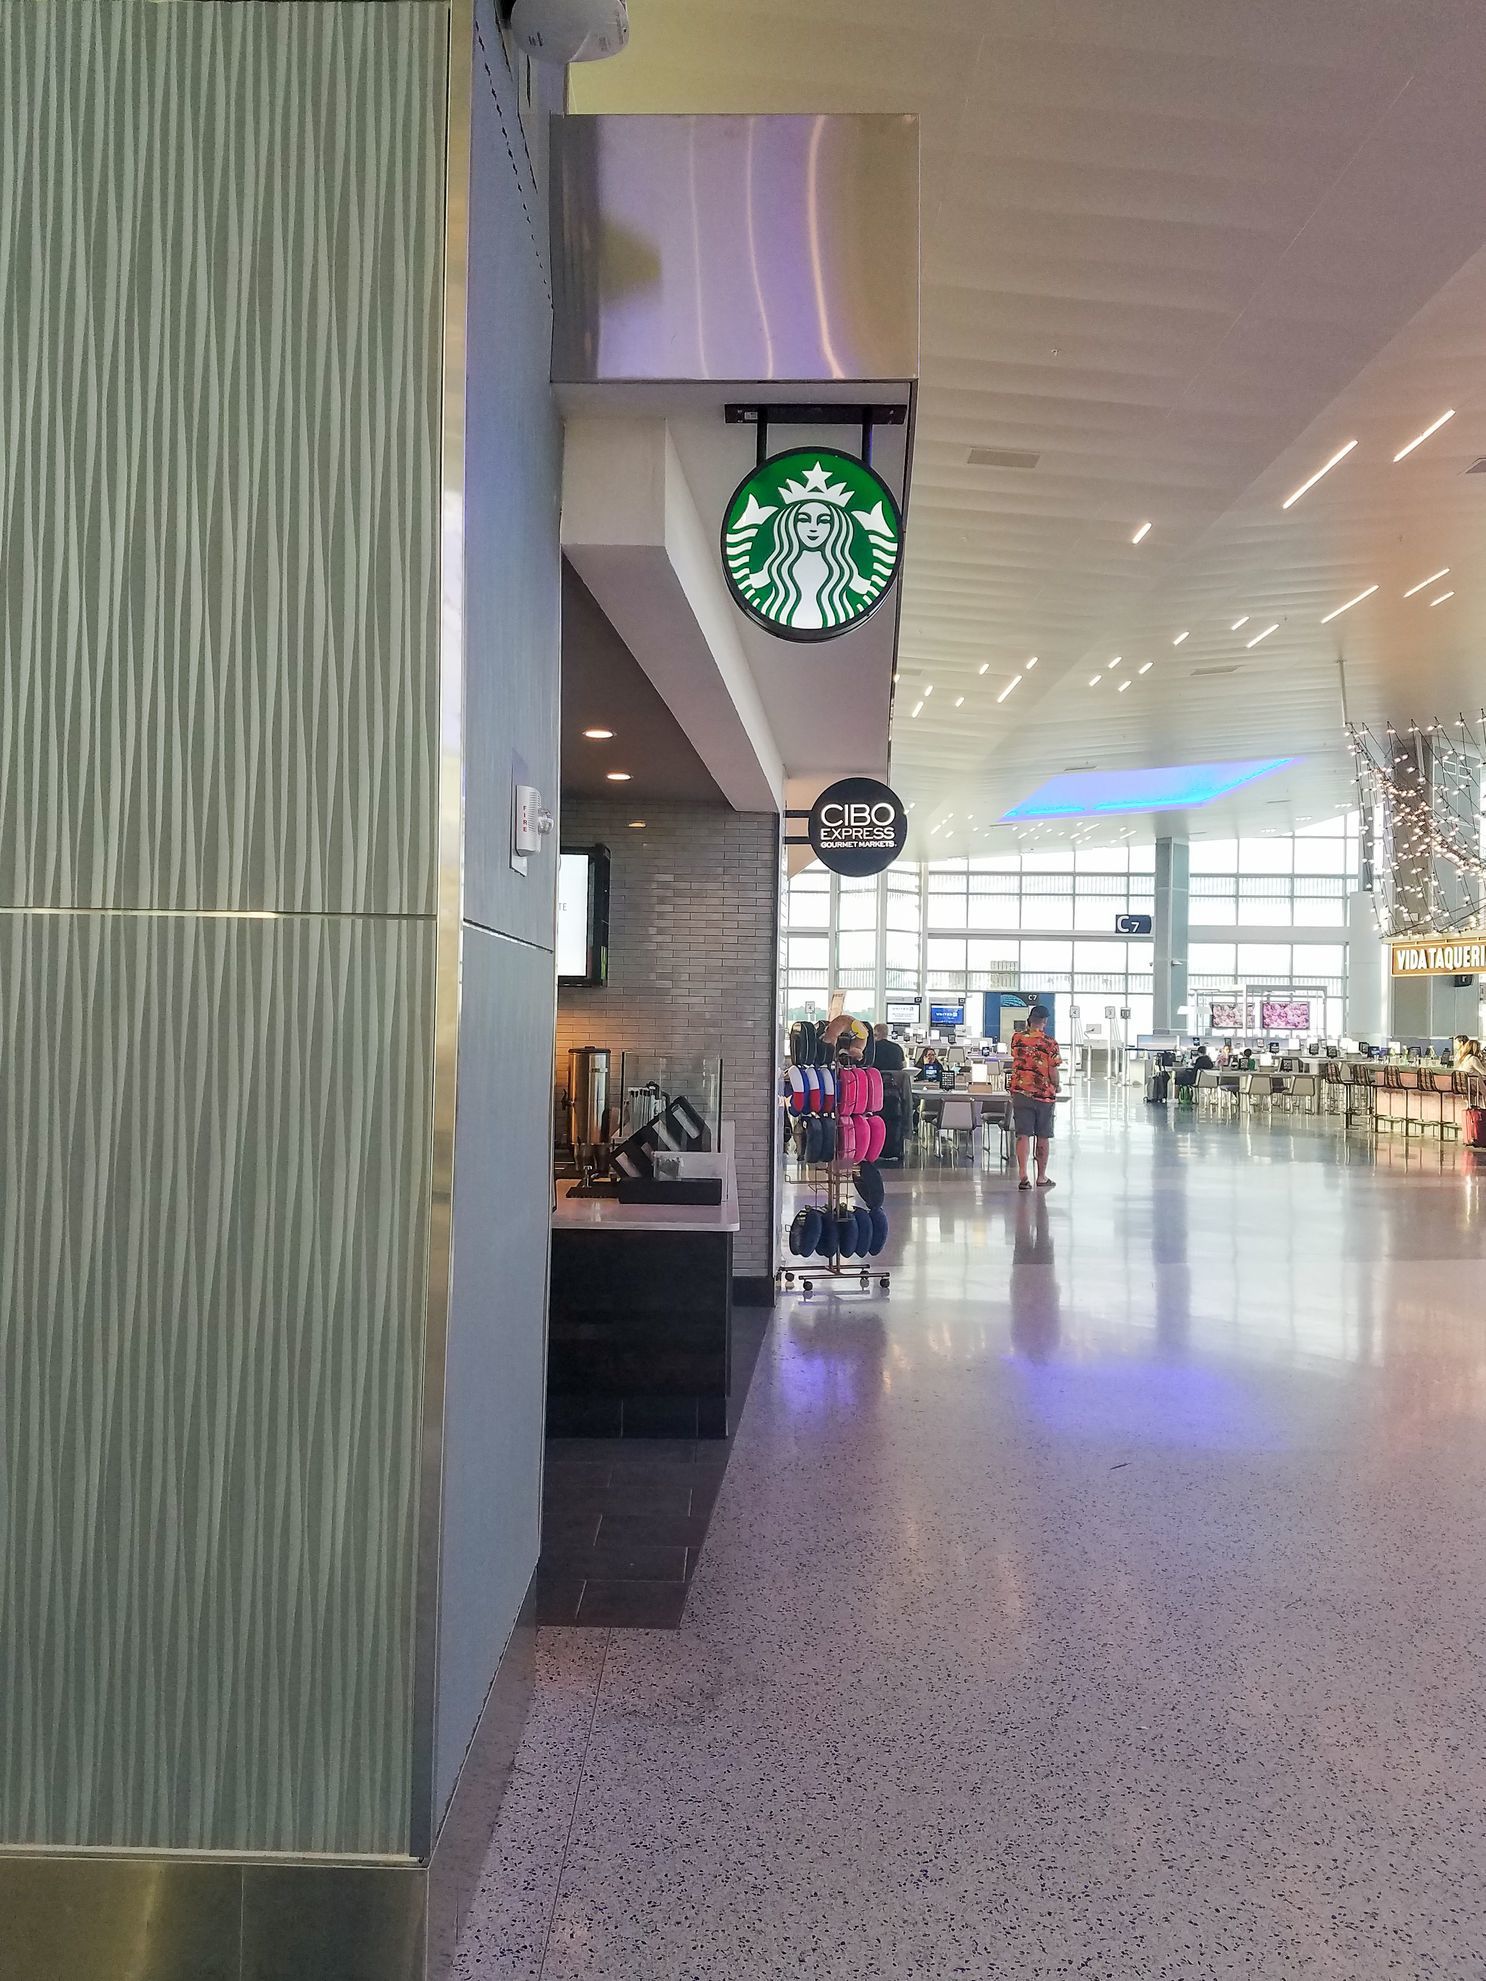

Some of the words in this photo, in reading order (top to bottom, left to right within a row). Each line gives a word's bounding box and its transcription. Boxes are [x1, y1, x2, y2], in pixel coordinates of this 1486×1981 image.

[821, 802, 896, 827] CIBO
[820, 827, 895, 840] EXPRESS
[820, 840, 858, 849] GOURMET
[1396, 948, 1427, 970] VIDA
